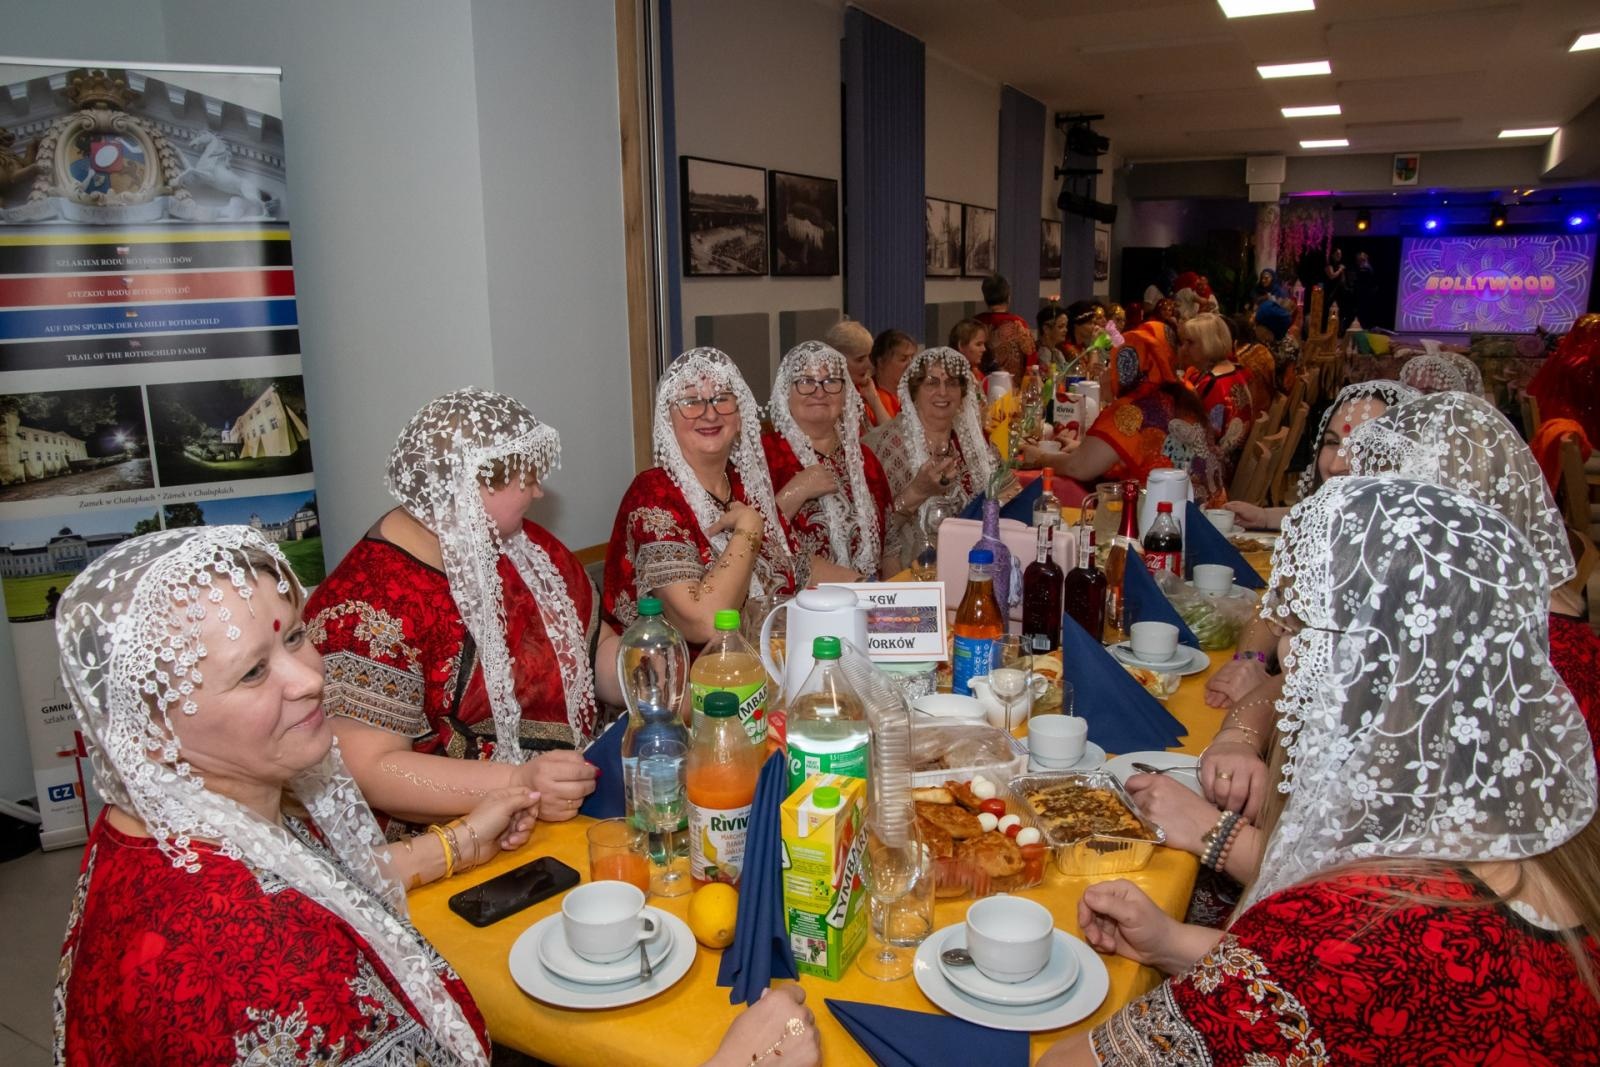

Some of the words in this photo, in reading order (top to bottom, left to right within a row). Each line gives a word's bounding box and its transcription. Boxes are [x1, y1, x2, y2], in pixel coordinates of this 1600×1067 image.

[56, 258, 100, 268] SZLAKIEM
[100, 257, 125, 266] RODU
[1425, 276, 1556, 296] BOLLYWOOD
[107, 289, 131, 297] RODU
[44, 325, 62, 333] AUF
[63, 324, 81, 332] DEN
[82, 322, 115, 332] SPUREN
[115, 321, 133, 330] DER
[134, 319, 166, 329] FAMILIE
[168, 317, 220, 327] ROTHSCHILD
[66, 353, 91, 362] TRAIL
[93, 352, 105, 361] OF
[105, 351, 123, 360] THE
[124, 349, 177, 359] ROTHSCHILD
[178, 346, 207, 357] FAMILY
[869, 592, 898, 605] KGW
[867, 636, 916, 649] WORKÓW
